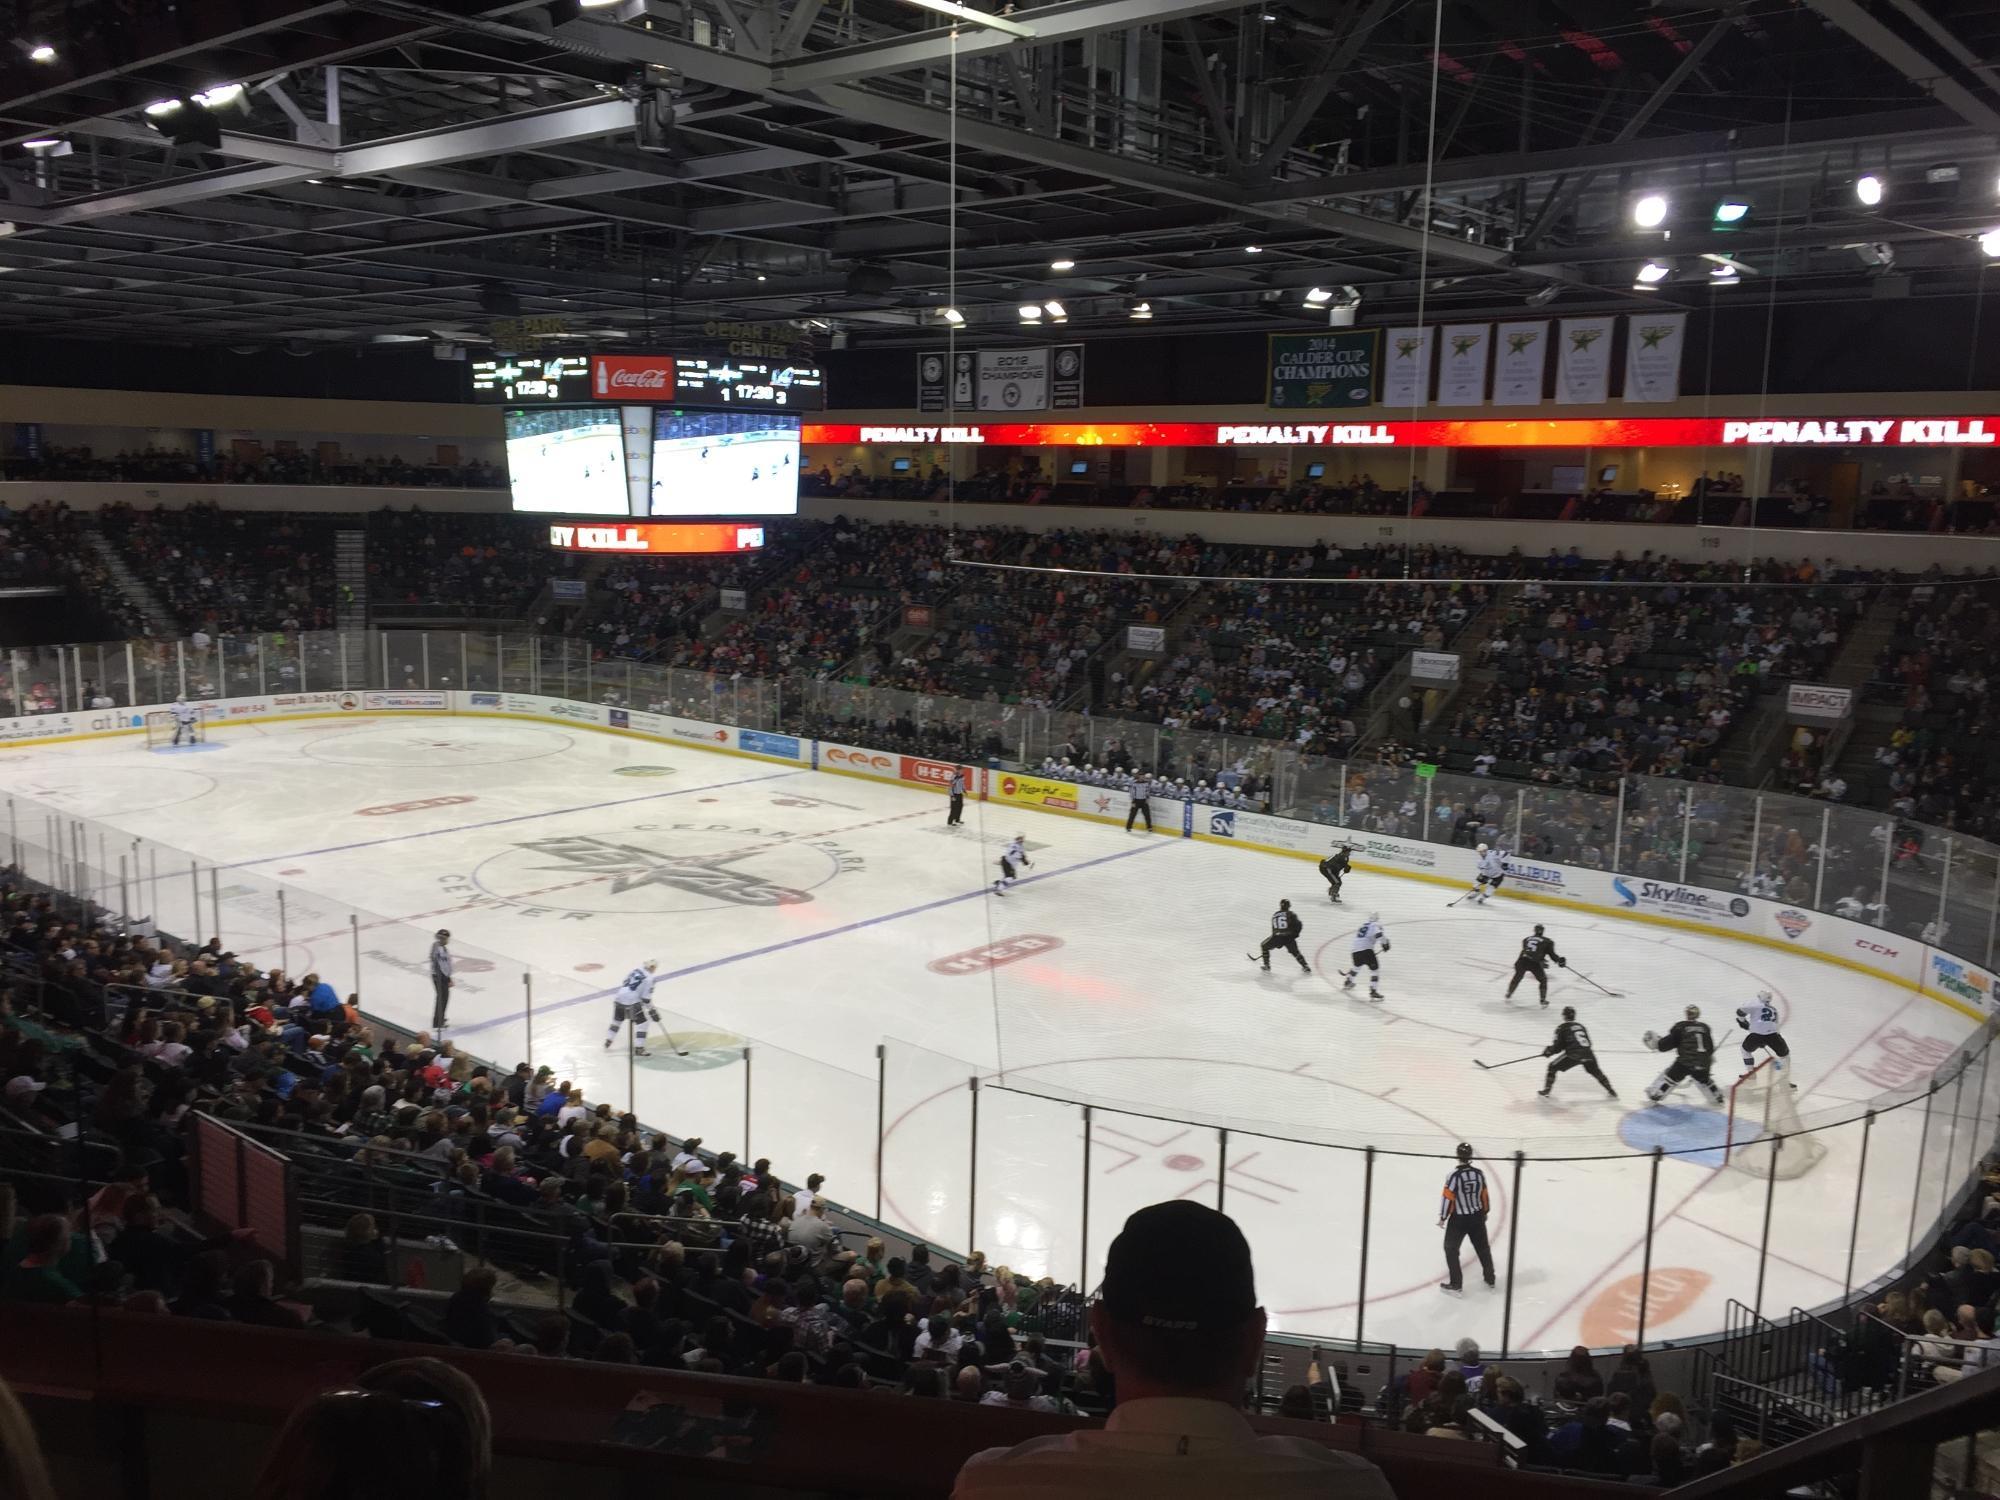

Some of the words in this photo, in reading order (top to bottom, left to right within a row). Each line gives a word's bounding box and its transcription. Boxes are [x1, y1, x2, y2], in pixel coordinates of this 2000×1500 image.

[1309, 338, 1337, 351] 2014
[1279, 351, 1335, 365] CALDER
[1336, 349, 1365, 363] CUP
[981, 371, 1044, 380] CHAMPIONS
[1273, 363, 1370, 379] CHAMPIONS
[721, 388, 730, 401] 1
[776, 391, 787, 404] 3
[861, 427, 939, 442] PENALTY
[941, 427, 985, 442] KILL
[1218, 426, 1329, 443] PENALTY
[1333, 425, 1395, 443] KILL
[1723, 421, 1894, 443] PENALTY
[1900, 420, 1995, 443] KILL
[577, 527, 648, 549] KILL
[633, 823, 798, 838] CEDAR
[1212, 817, 1232, 836] SN
[809, 841, 868, 874] PARK
[1505, 863, 1562, 883] ALIBUR
[437, 874, 595, 921] CENTER
[1641, 881, 1709, 904] Skyline
[1273, 916, 1288, 929] 16
[1854, 939, 1899, 958] CCM
[1695, 1033, 1706, 1053] 1
[1462, 1180, 1480, 1194] 57
